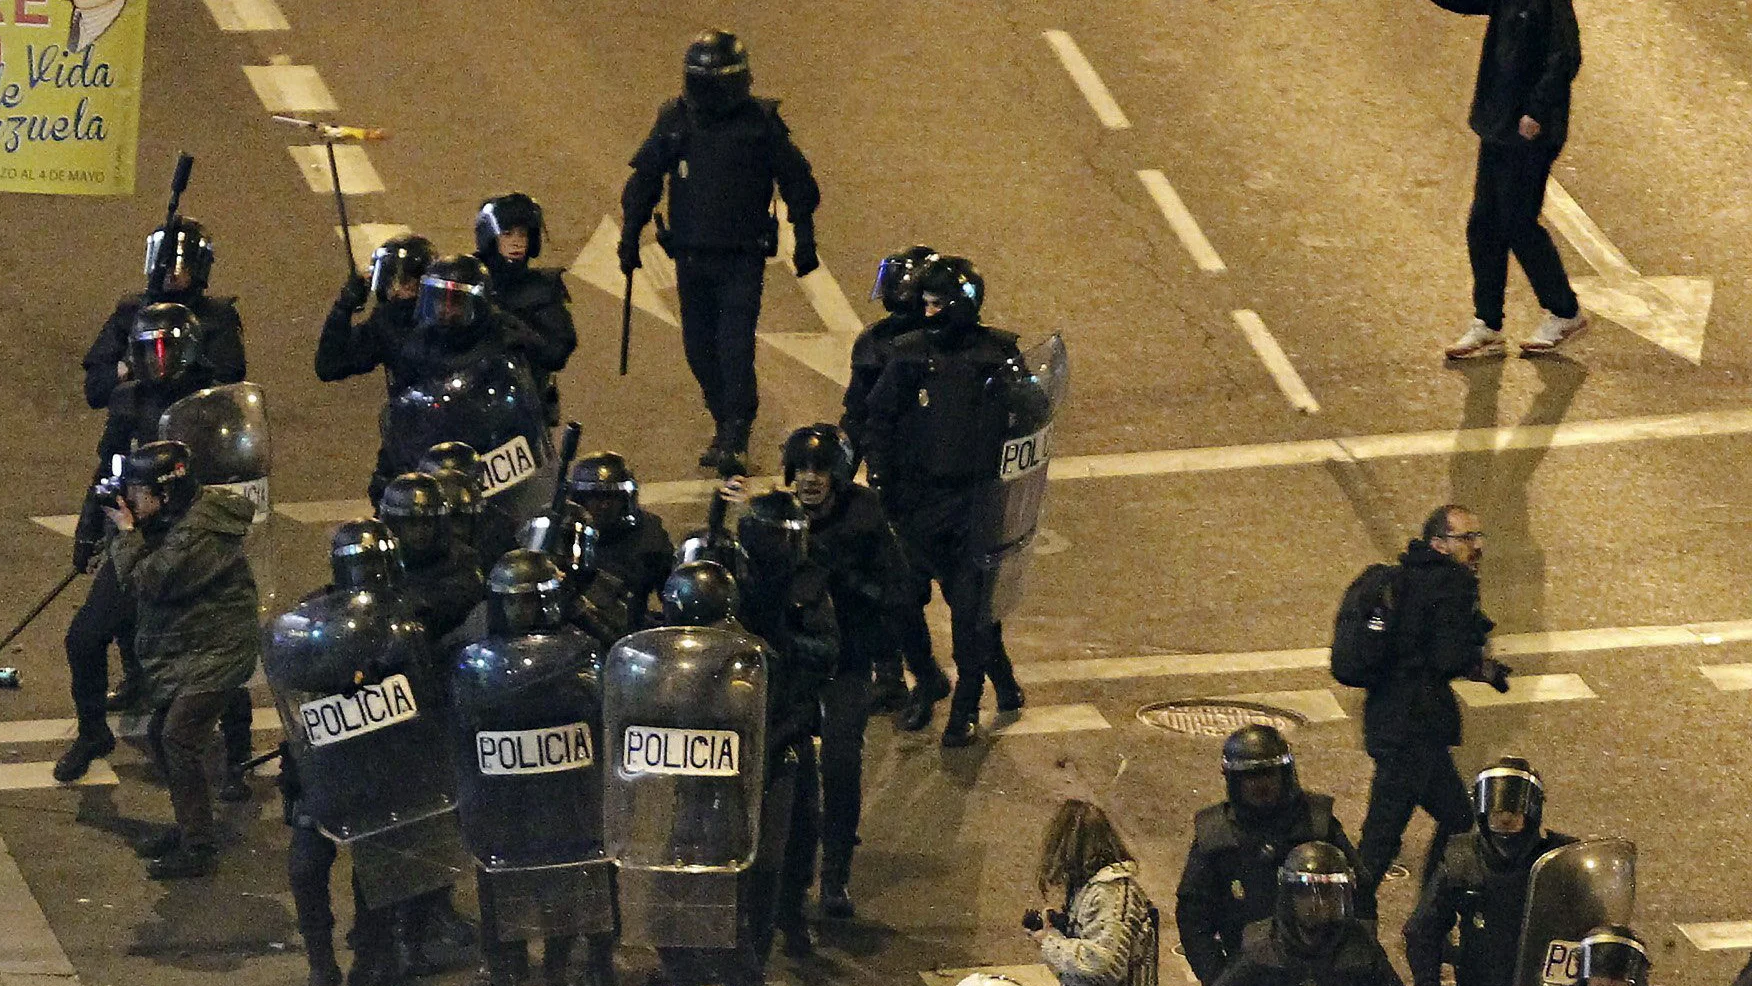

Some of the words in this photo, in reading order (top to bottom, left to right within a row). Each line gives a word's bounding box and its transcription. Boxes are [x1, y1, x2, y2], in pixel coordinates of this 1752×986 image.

[26, 43, 114, 88] Vida
[21, 168, 35, 180] AL
[38, 170, 46, 181] 4
[49, 170, 65, 182] DE
[68, 170, 105, 184] MAYO
[481, 444, 533, 491] ICIA
[303, 685, 416, 742] POLICIA
[480, 726, 591, 771] POLICIA
[627, 732, 737, 771] POLICIA
